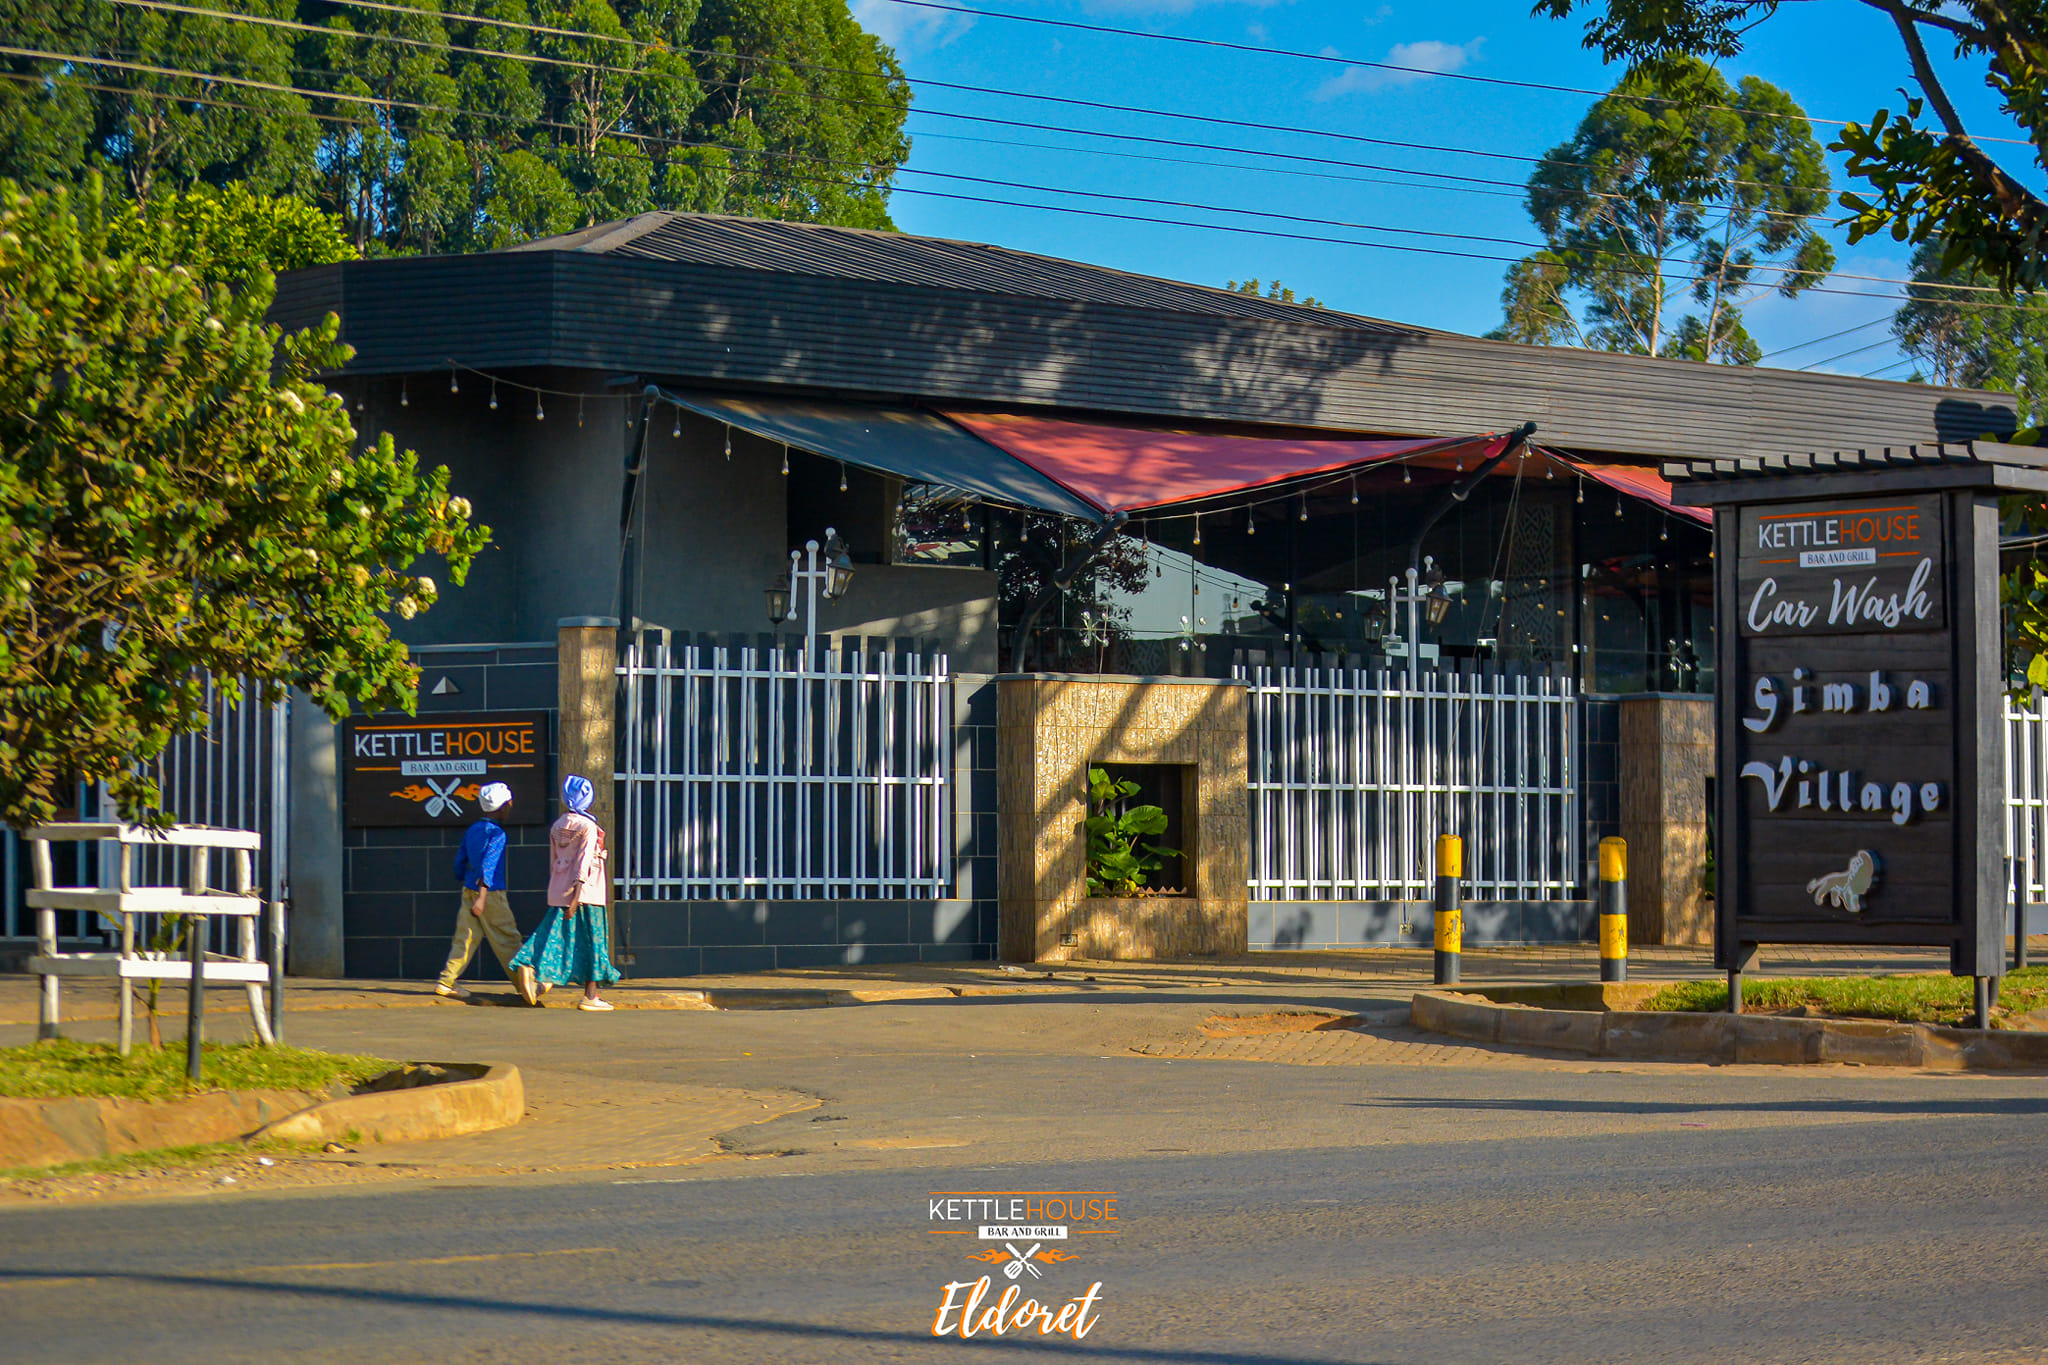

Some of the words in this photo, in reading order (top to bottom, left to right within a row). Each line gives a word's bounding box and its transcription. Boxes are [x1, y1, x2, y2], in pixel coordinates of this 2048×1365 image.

[1758, 515, 1920, 548] KETTLEHOUSE
[1807, 553, 1826, 565] BAR
[1828, 552, 1845, 564] AND
[1847, 551, 1870, 562] GRILL
[1747, 578, 1818, 632] Car
[1828, 558, 1932, 628] Wash
[1743, 668, 1930, 733] Simba
[354, 730, 535, 757] KETTLEHOUSE
[410, 763, 431, 773] BAR
[433, 762, 452, 773] AND
[454, 762, 480, 772] GRILL
[1740, 756, 1939, 825] Village
